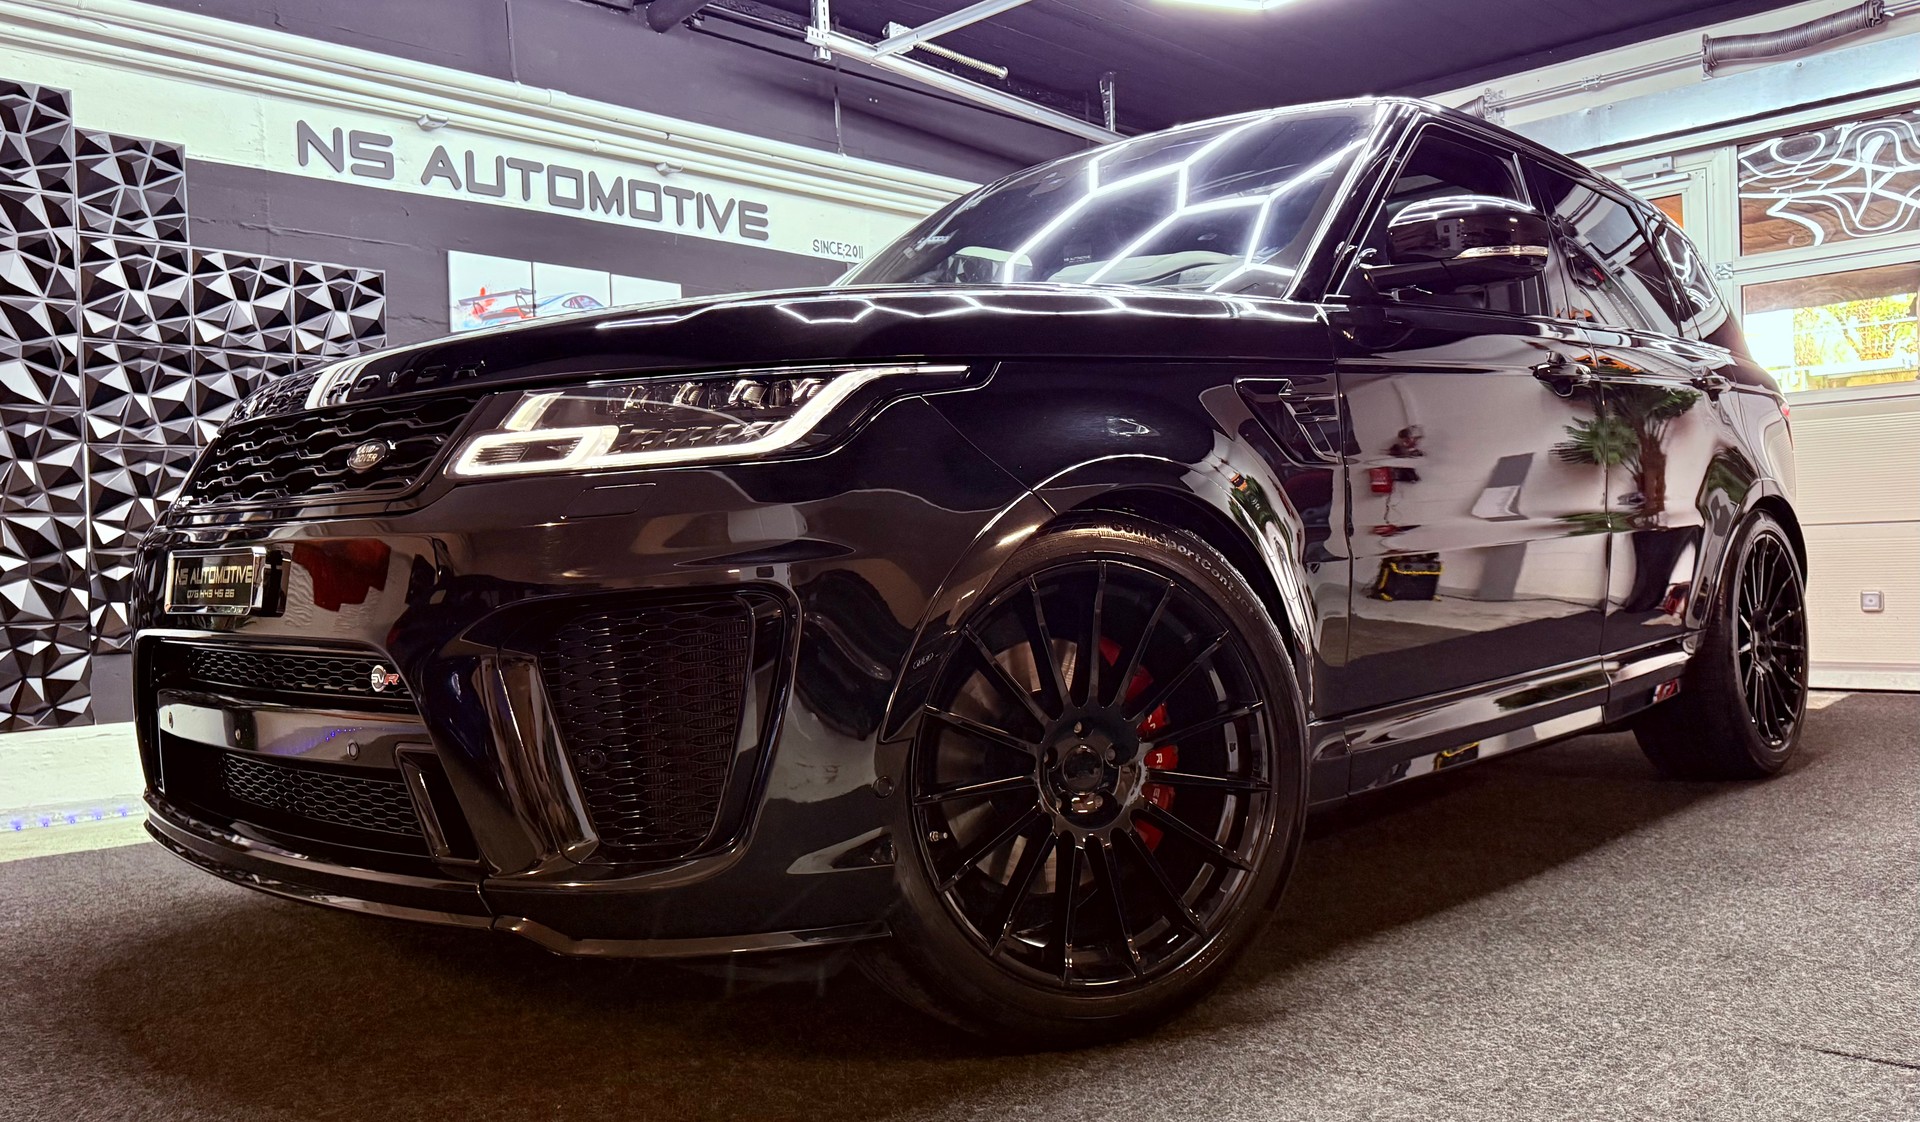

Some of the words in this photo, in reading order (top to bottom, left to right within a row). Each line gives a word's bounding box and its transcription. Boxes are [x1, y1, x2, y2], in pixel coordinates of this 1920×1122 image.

[297, 119, 395, 181] NS
[420, 145, 769, 242] AUTOMOTIVE
[175, 567, 189, 586] NS
[189, 565, 253, 585] AUTOMOTIVE
